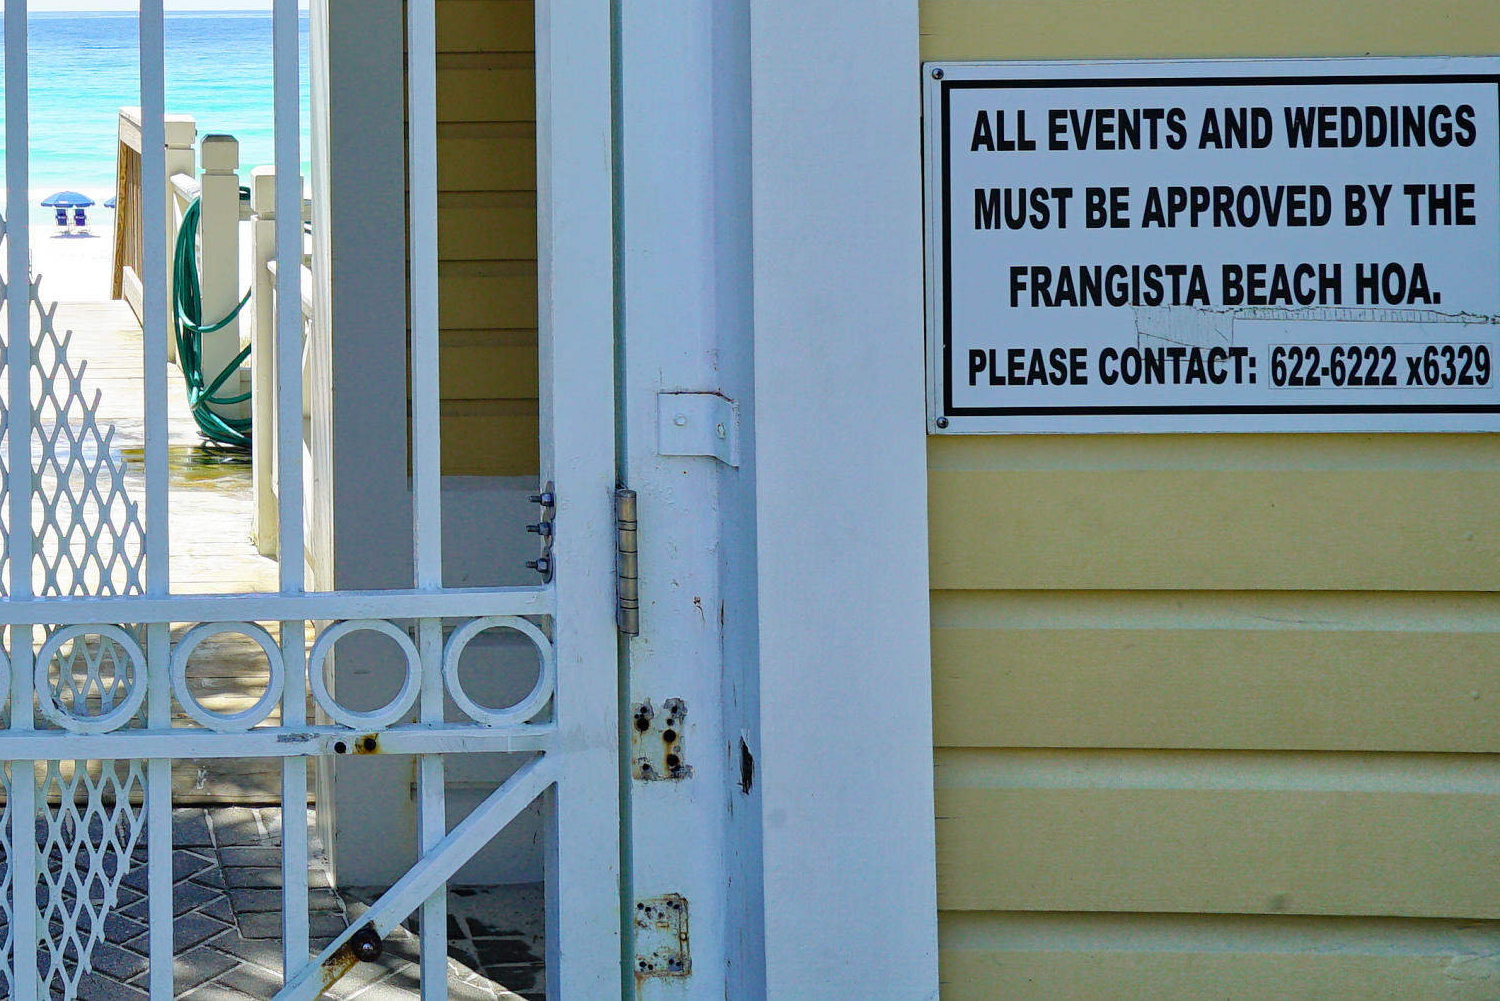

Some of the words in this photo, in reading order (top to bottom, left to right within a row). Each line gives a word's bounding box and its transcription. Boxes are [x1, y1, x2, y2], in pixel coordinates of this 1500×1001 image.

[971, 110, 1036, 151] ALL
[1049, 108, 1187, 150] EVENTS
[1199, 107, 1273, 149] AND
[1284, 105, 1476, 148] WEDDINGS
[975, 188, 1072, 229] MUST
[1086, 187, 1130, 228] BE
[1142, 185, 1331, 228] APPROVED
[1345, 185, 1392, 226] BY
[1404, 184, 1476, 225] THE
[1009, 264, 1210, 307] FRANGISTA
[1223, 263, 1342, 305] BEACH
[1356, 263, 1441, 305] HOA.
[969, 348, 1088, 385] PLEASE
[1099, 347, 1256, 385] CONTACT:
[1271, 346, 1397, 386] 622-6222
[1406, 345, 1490, 386] x6329
